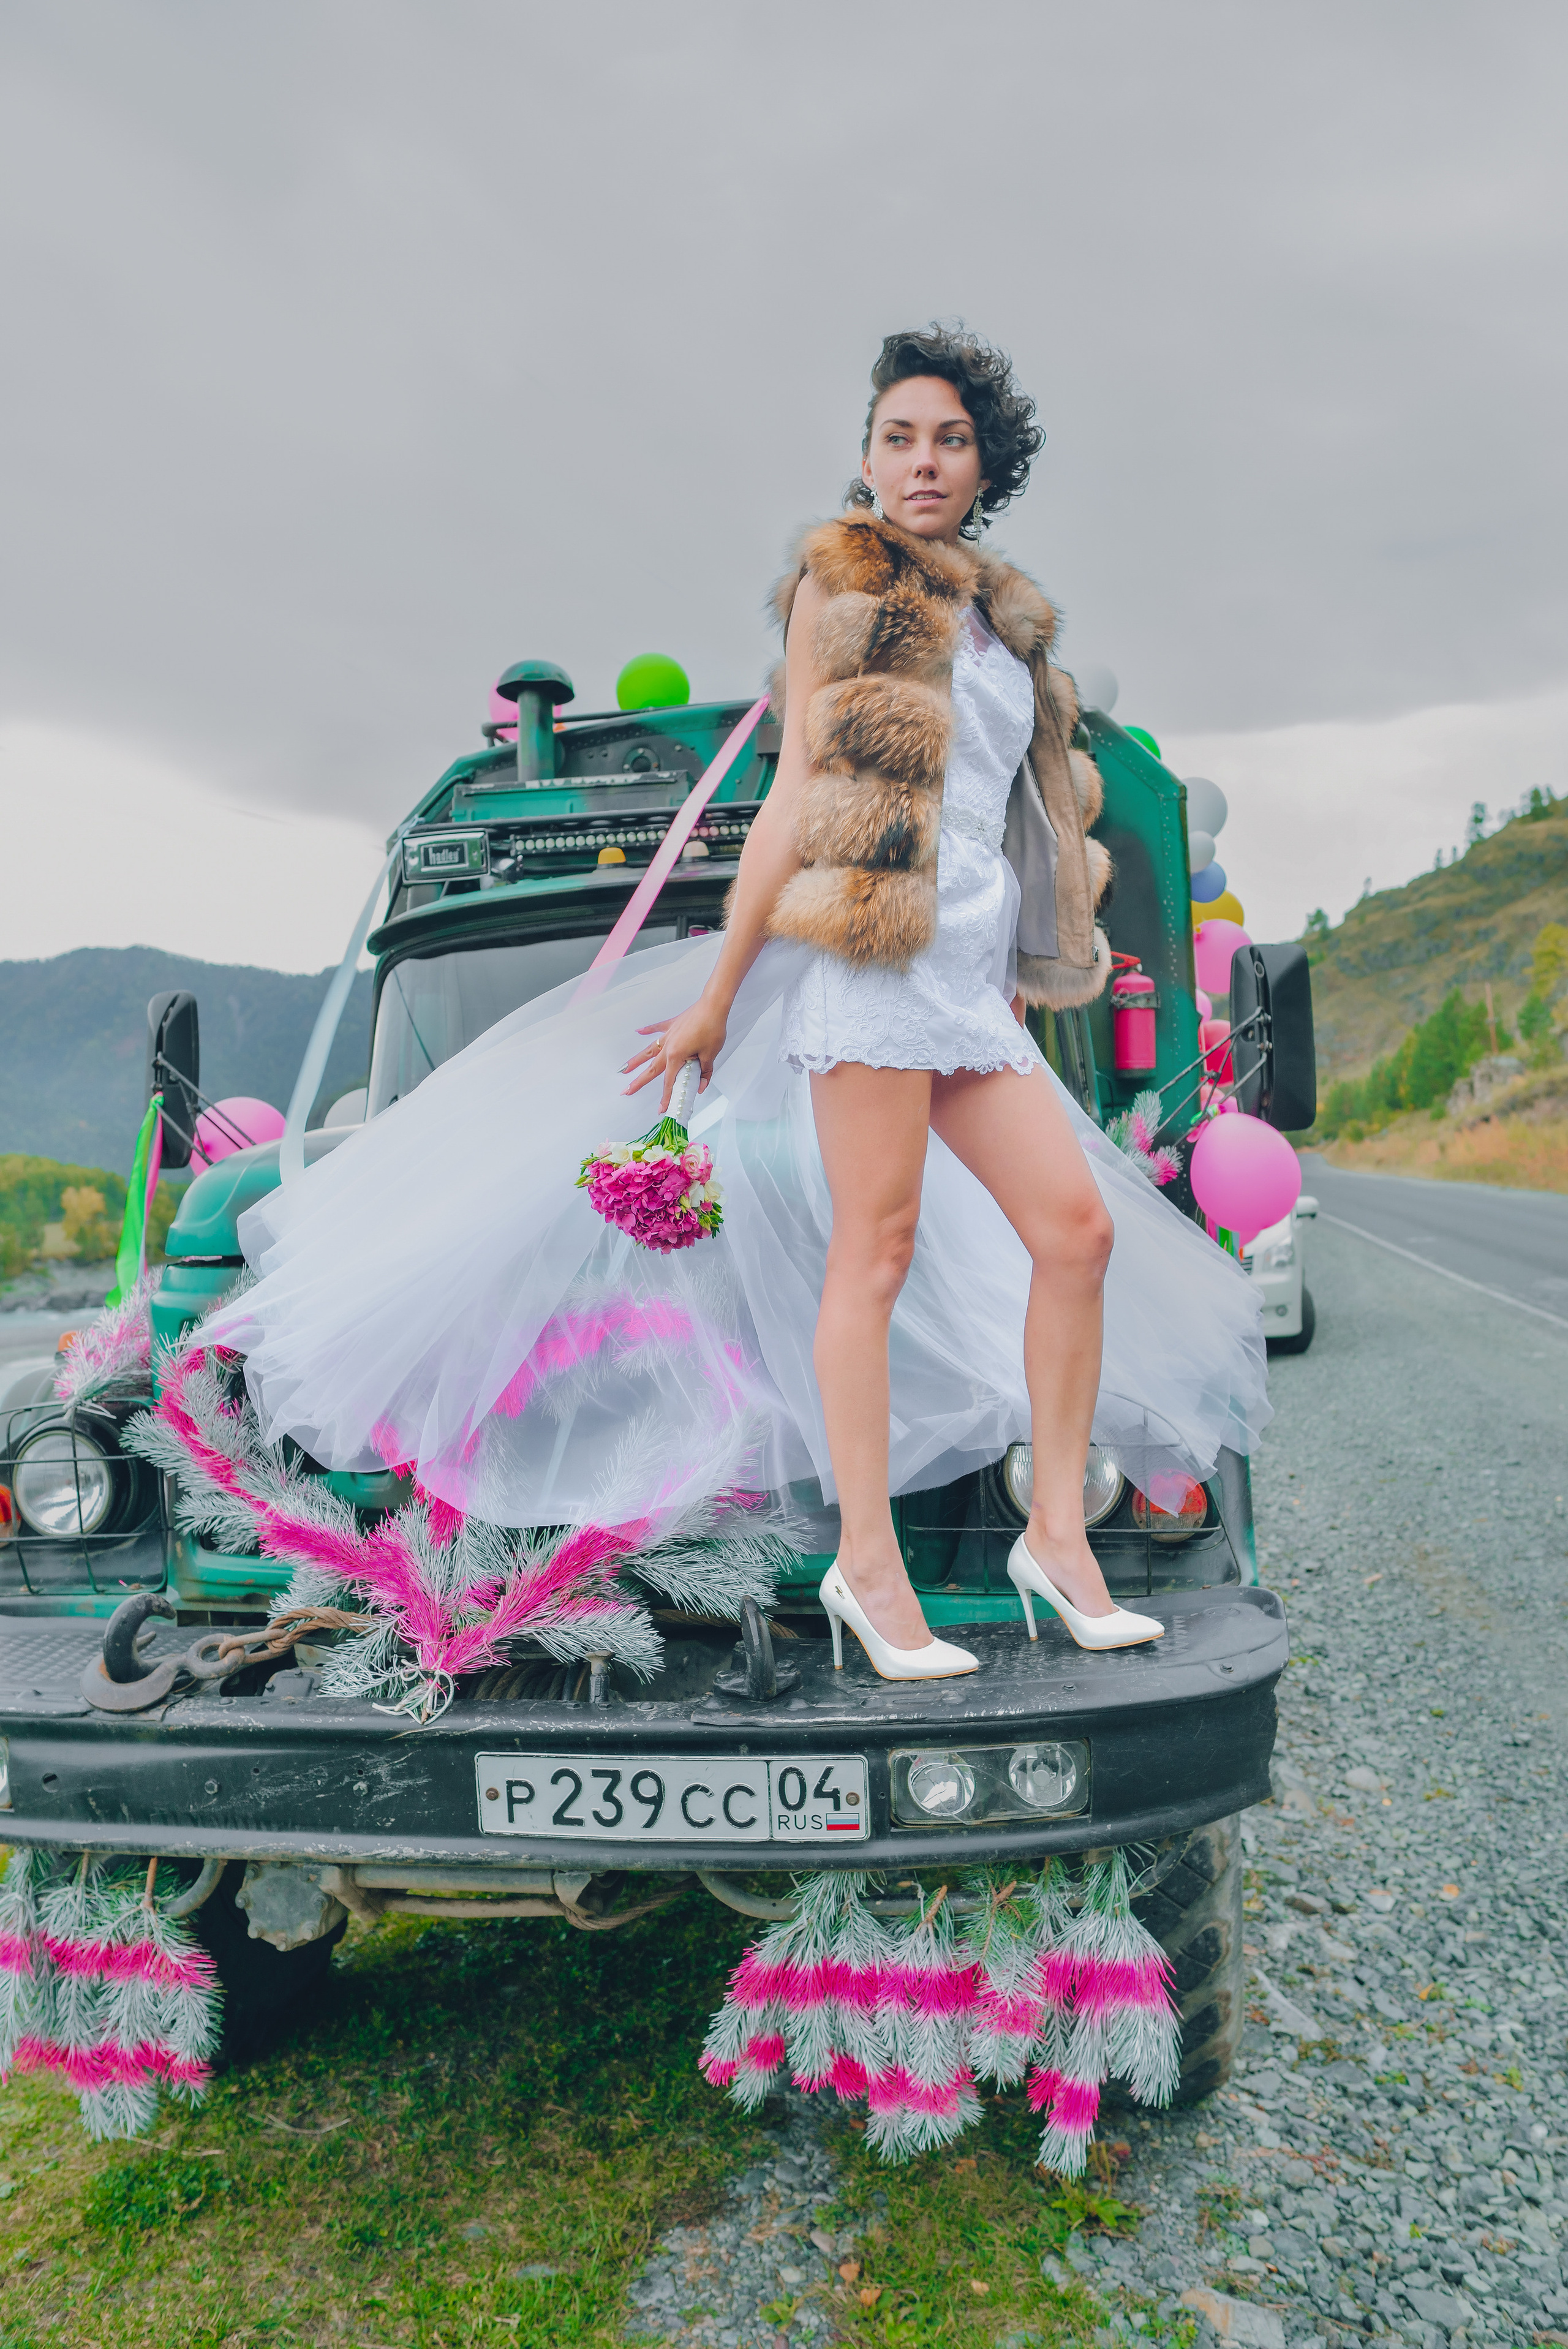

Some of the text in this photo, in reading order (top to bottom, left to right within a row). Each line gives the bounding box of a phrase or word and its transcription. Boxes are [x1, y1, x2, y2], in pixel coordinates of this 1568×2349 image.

[549, 1766, 665, 1829] 239
[777, 1765, 841, 1811] 04
[777, 1815, 823, 1831] RUS
